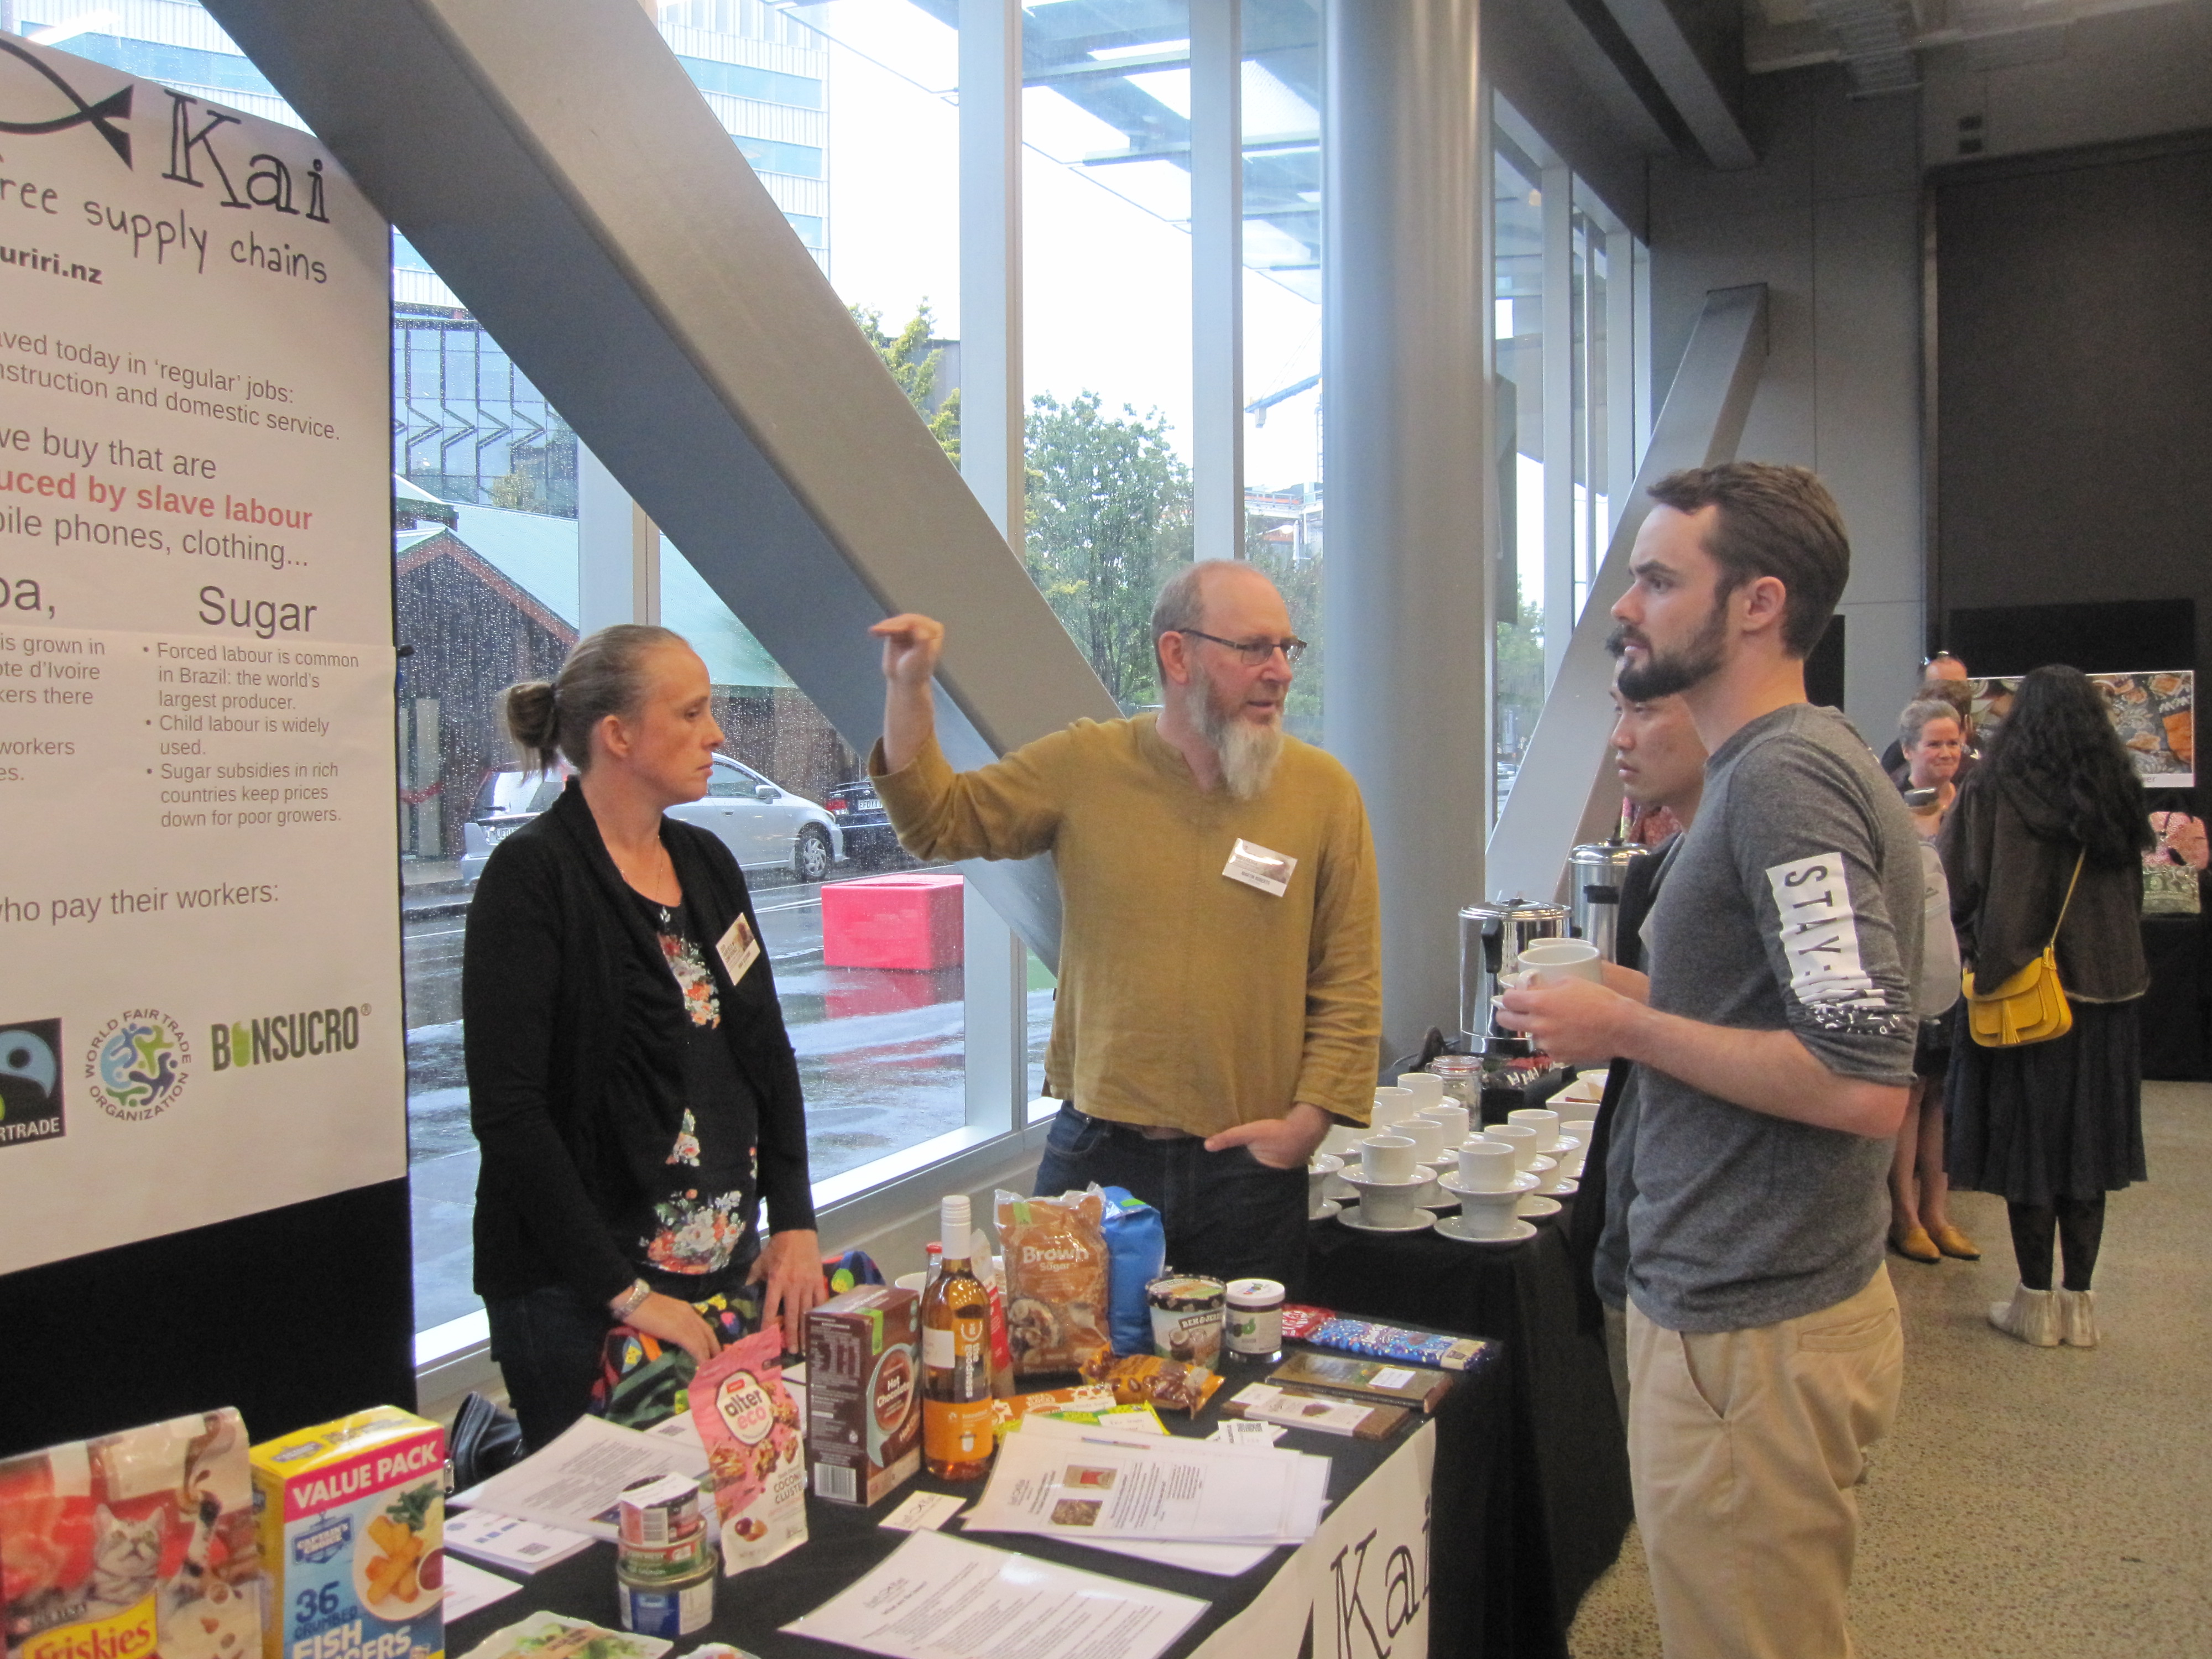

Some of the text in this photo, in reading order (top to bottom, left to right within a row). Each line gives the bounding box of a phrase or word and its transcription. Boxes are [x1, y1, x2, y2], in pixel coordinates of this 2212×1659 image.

[161, 88, 330, 224] Kai
[84, 201, 207, 274] supply
[230, 231, 327, 284] chains
[0, 332, 47, 356] ved
[56, 340, 120, 375] today
[127, 352, 147, 376] in
[244, 376, 293, 407] jobs:
[116, 386, 157, 407] and
[166, 392, 259, 426] domestic
[267, 414, 339, 440] service.
[44, 427, 98, 468] buy
[108, 439, 163, 472] that
[173, 455, 216, 479] are
[88, 475, 127, 512] by
[137, 484, 215, 518] slave
[226, 494, 312, 530] labour
[55, 514, 170, 555] phones,
[199, 586, 317, 639] Sugar
[23, 638, 82, 659] grown
[88, 638, 105, 656] in
[157, 643, 358, 667] Forced labour is common
[159, 669, 174, 684] in
[180, 667, 230, 684] Brazil:
[237, 670, 262, 686] the
[44, 687, 93, 705] there
[159, 690, 295, 712] largest producer.
[160, 715, 330, 737] Child labour is widely
[160, 739, 205, 755] used.
[161, 762, 338, 783] Sugar subsidies in rich
[161, 786, 328, 804] countries keep prices
[161, 810, 341, 828] down for poor growers.
[0, 882, 278, 926] ho pay their workers:
[85, 1008, 191, 1078] WORLD FAIR TRADE
[90, 1072, 189, 1121] ORGANIZATION
[1023, 1246, 1089, 1264] Brown
[1040, 1262, 1071, 1272] Sugar
[724, 1390, 763, 1417] alter
[737, 1406, 767, 1430] eco
[293, 1440, 438, 1509] VALUE PACK
[295, 1580, 340, 1624] 36
